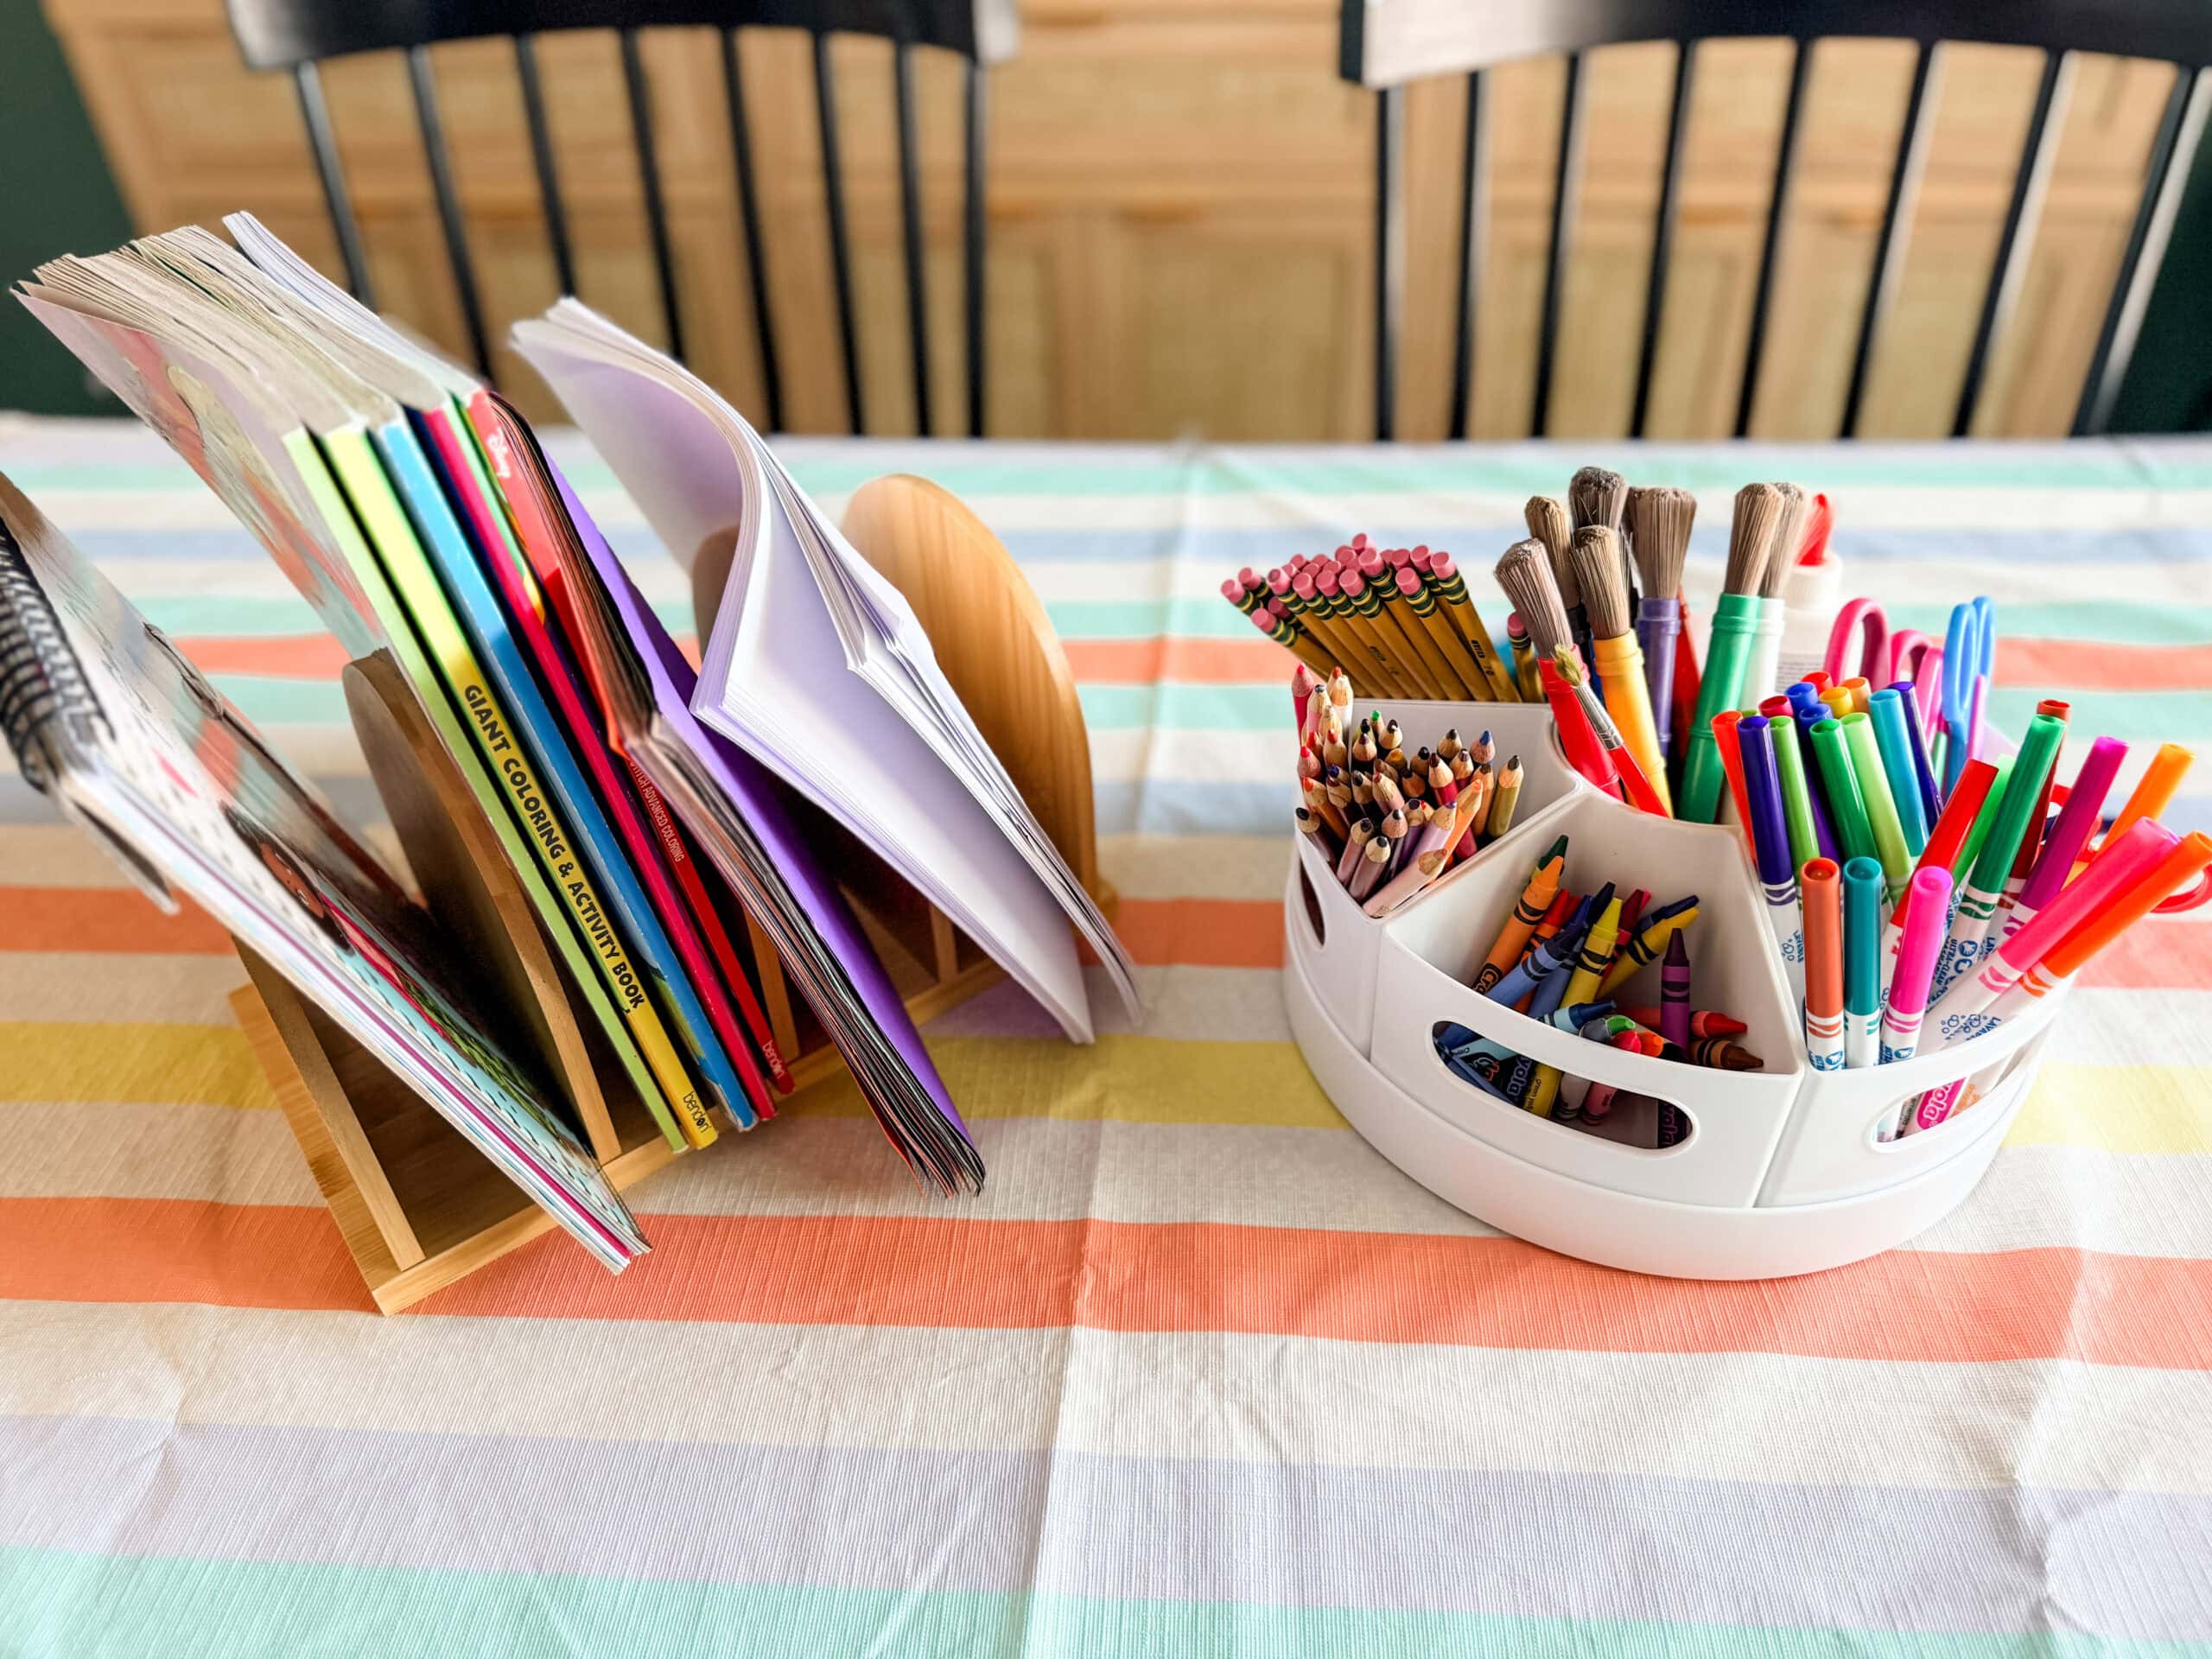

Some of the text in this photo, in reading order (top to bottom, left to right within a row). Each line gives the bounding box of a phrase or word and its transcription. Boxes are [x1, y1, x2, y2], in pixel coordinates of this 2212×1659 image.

[464, 684, 645, 1009] GIANT COLORING & ACTIVITY BOOK
[643, 785, 668, 827] ADVANCED
[661, 825, 684, 862] COLORING
[762, 1039, 785, 1079] bendon
[683, 1090, 712, 1134] bendon
